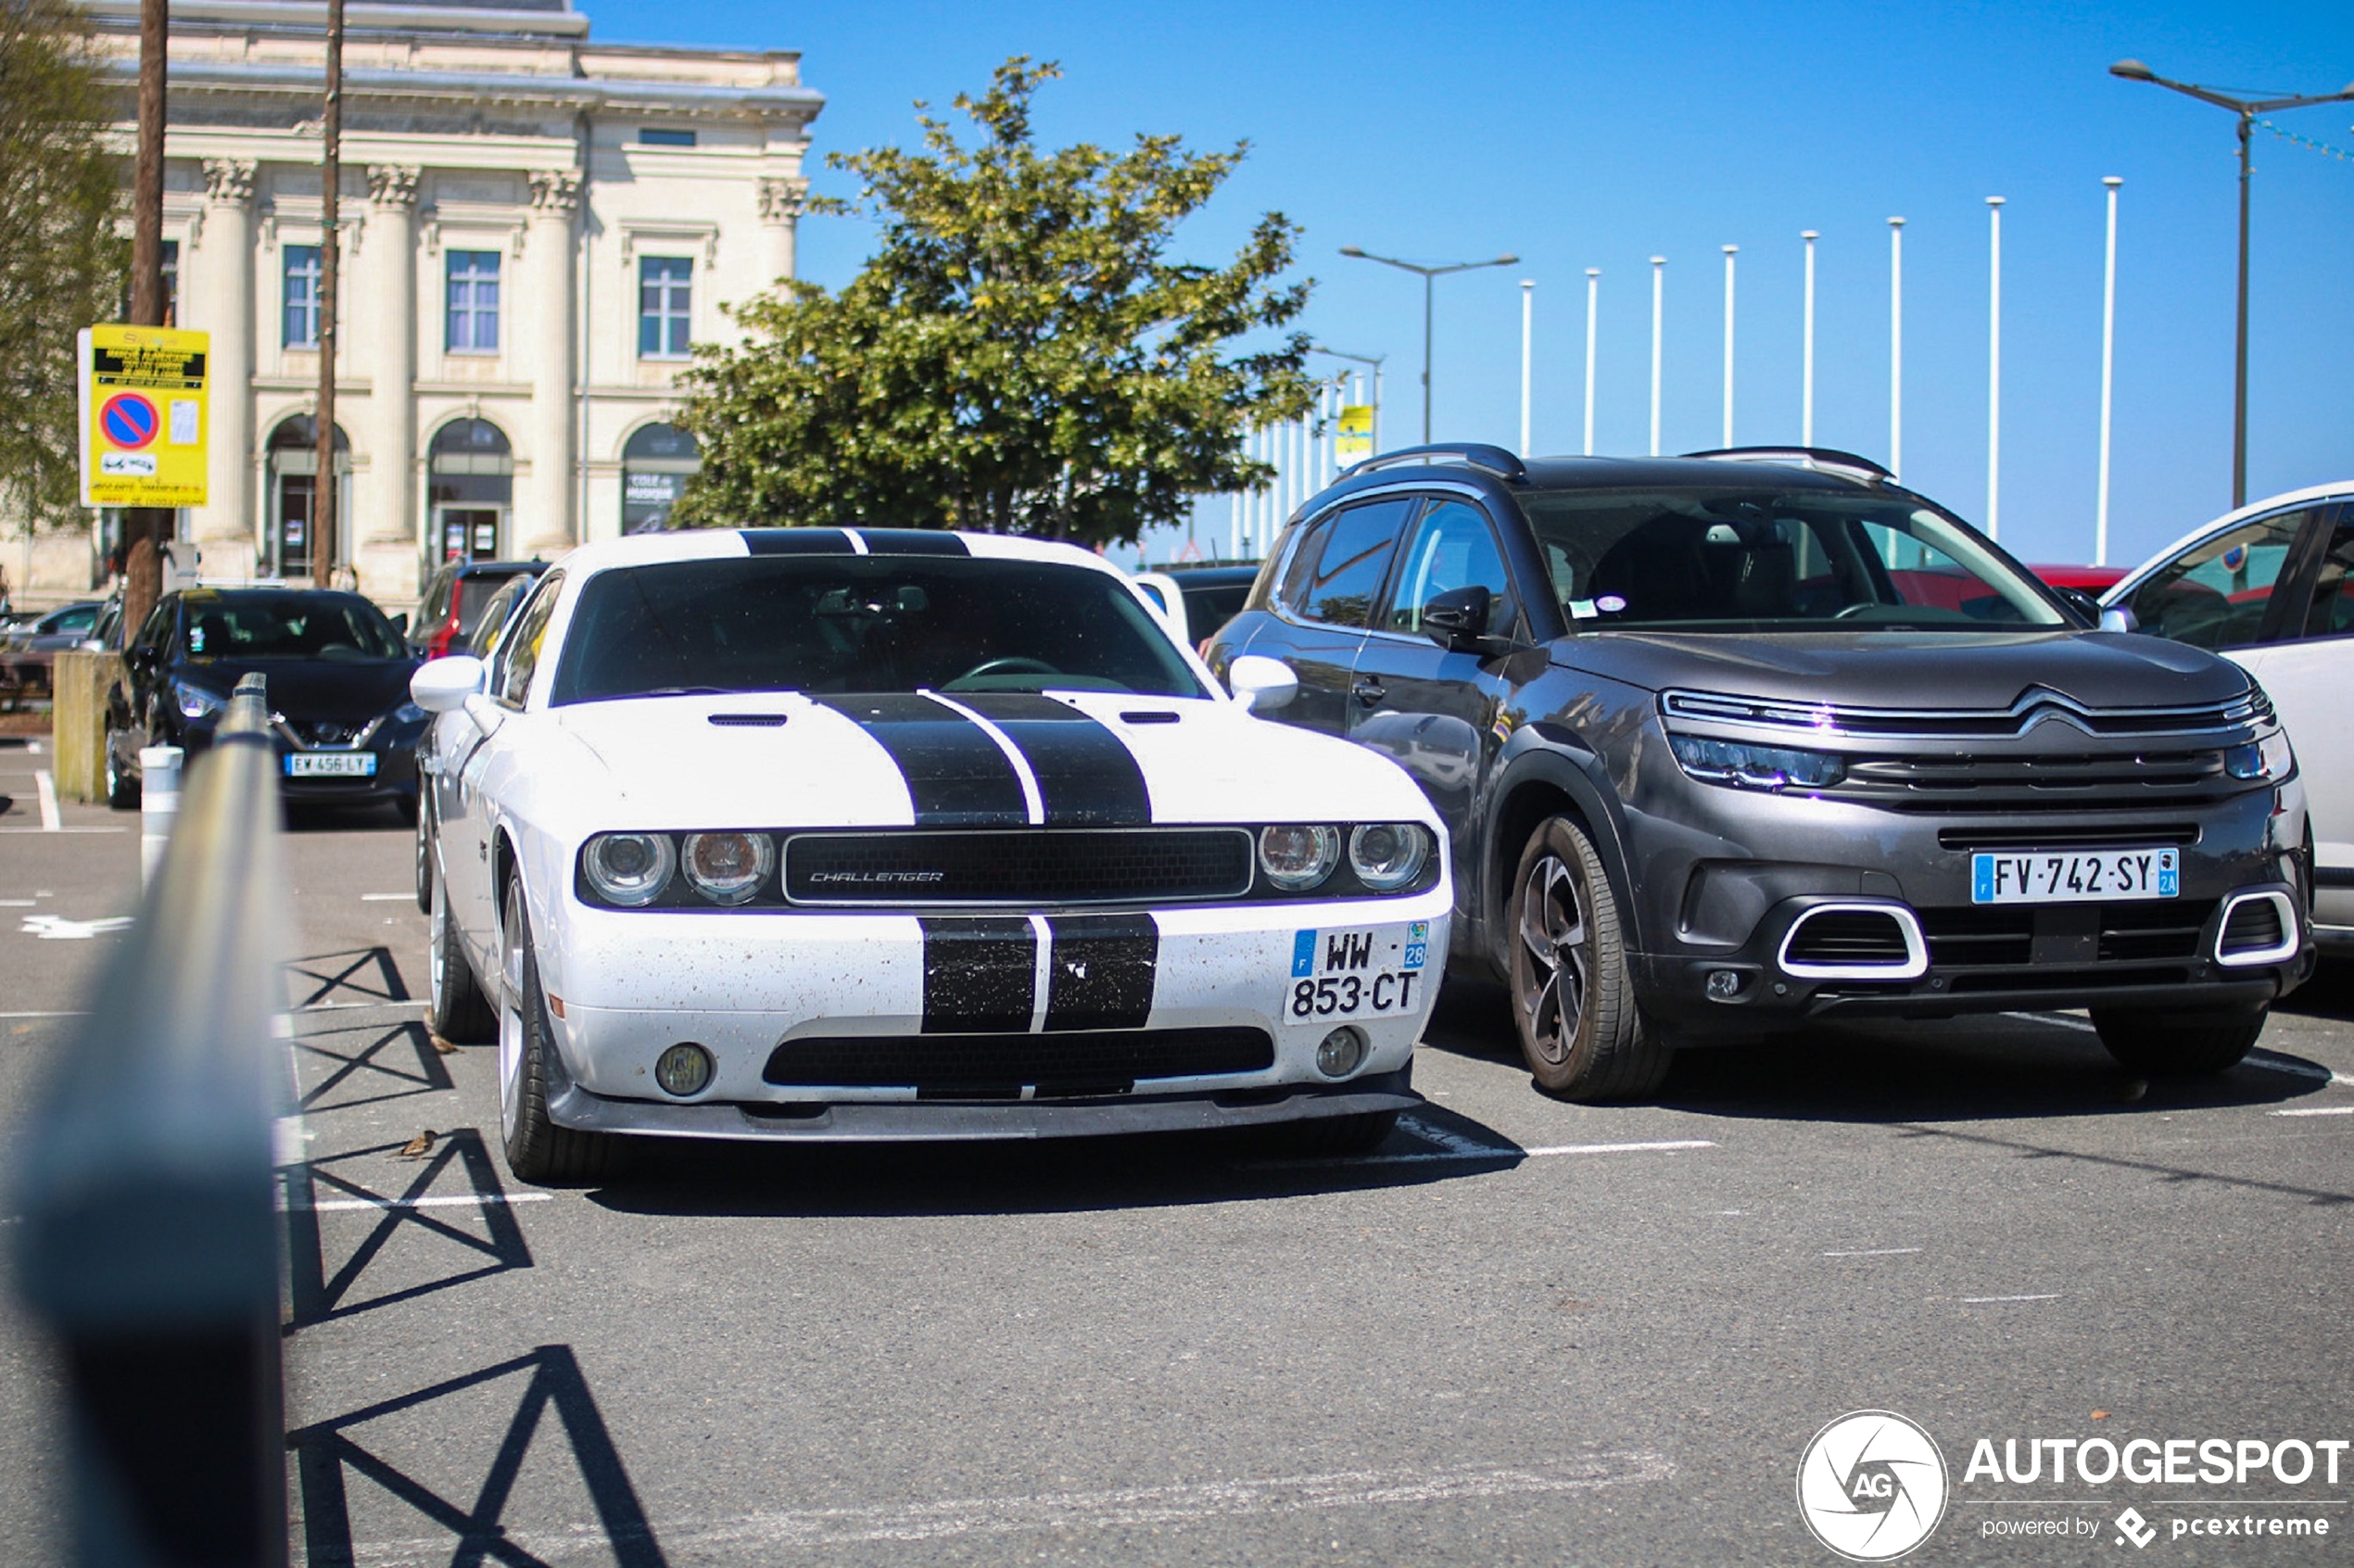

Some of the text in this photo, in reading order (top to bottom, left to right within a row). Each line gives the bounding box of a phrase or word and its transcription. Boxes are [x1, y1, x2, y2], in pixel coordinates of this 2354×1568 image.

[809, 872, 943, 882] CHALLENGER
[2159, 875, 2176, 892] 2A
[1405, 947, 1424, 965] 28
[1298, 959, 1307, 969] F
